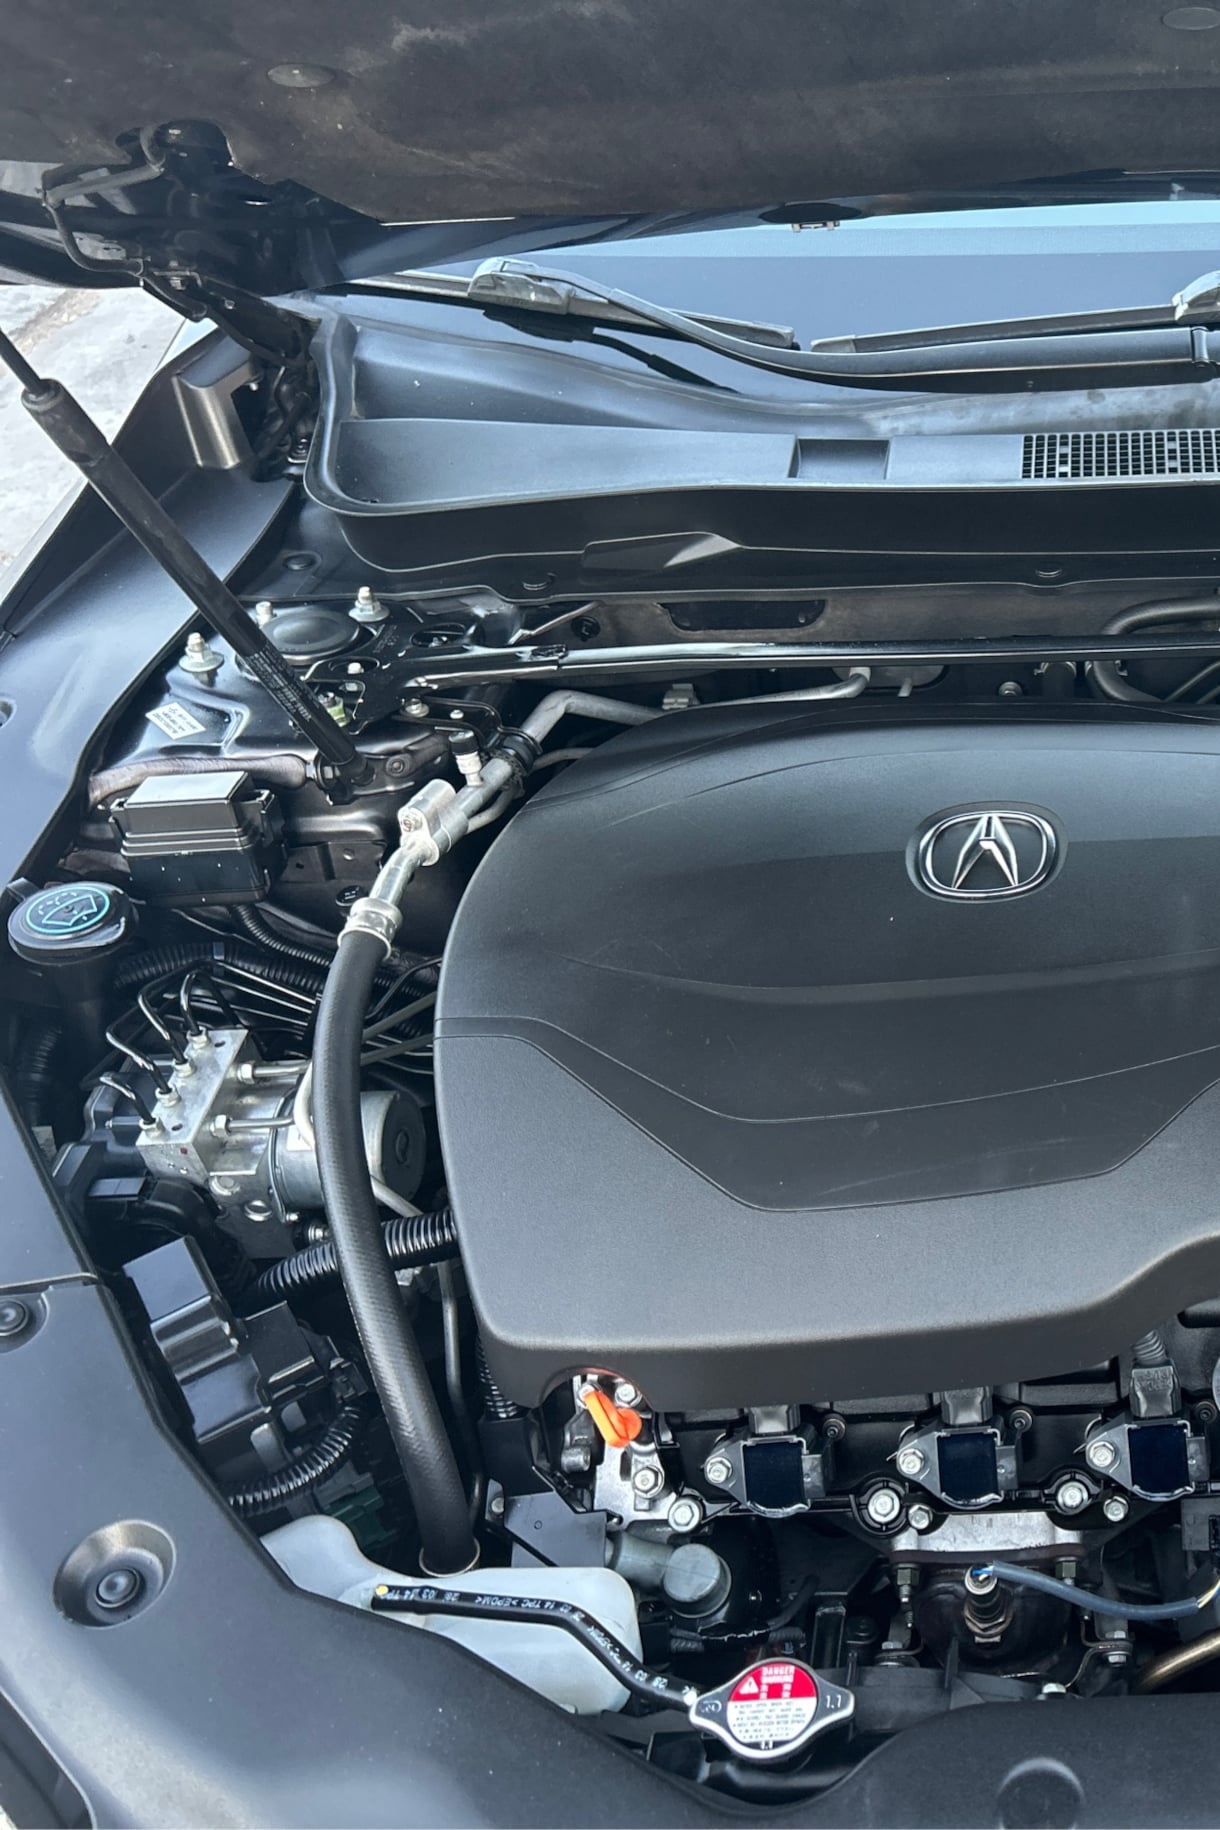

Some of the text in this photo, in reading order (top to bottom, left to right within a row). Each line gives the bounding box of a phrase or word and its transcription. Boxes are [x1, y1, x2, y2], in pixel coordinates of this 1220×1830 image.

[520, 1598, 543, 1609] TPC
[761, 1665, 796, 1676] DANGER
[825, 1694, 843, 1709] 1.1
